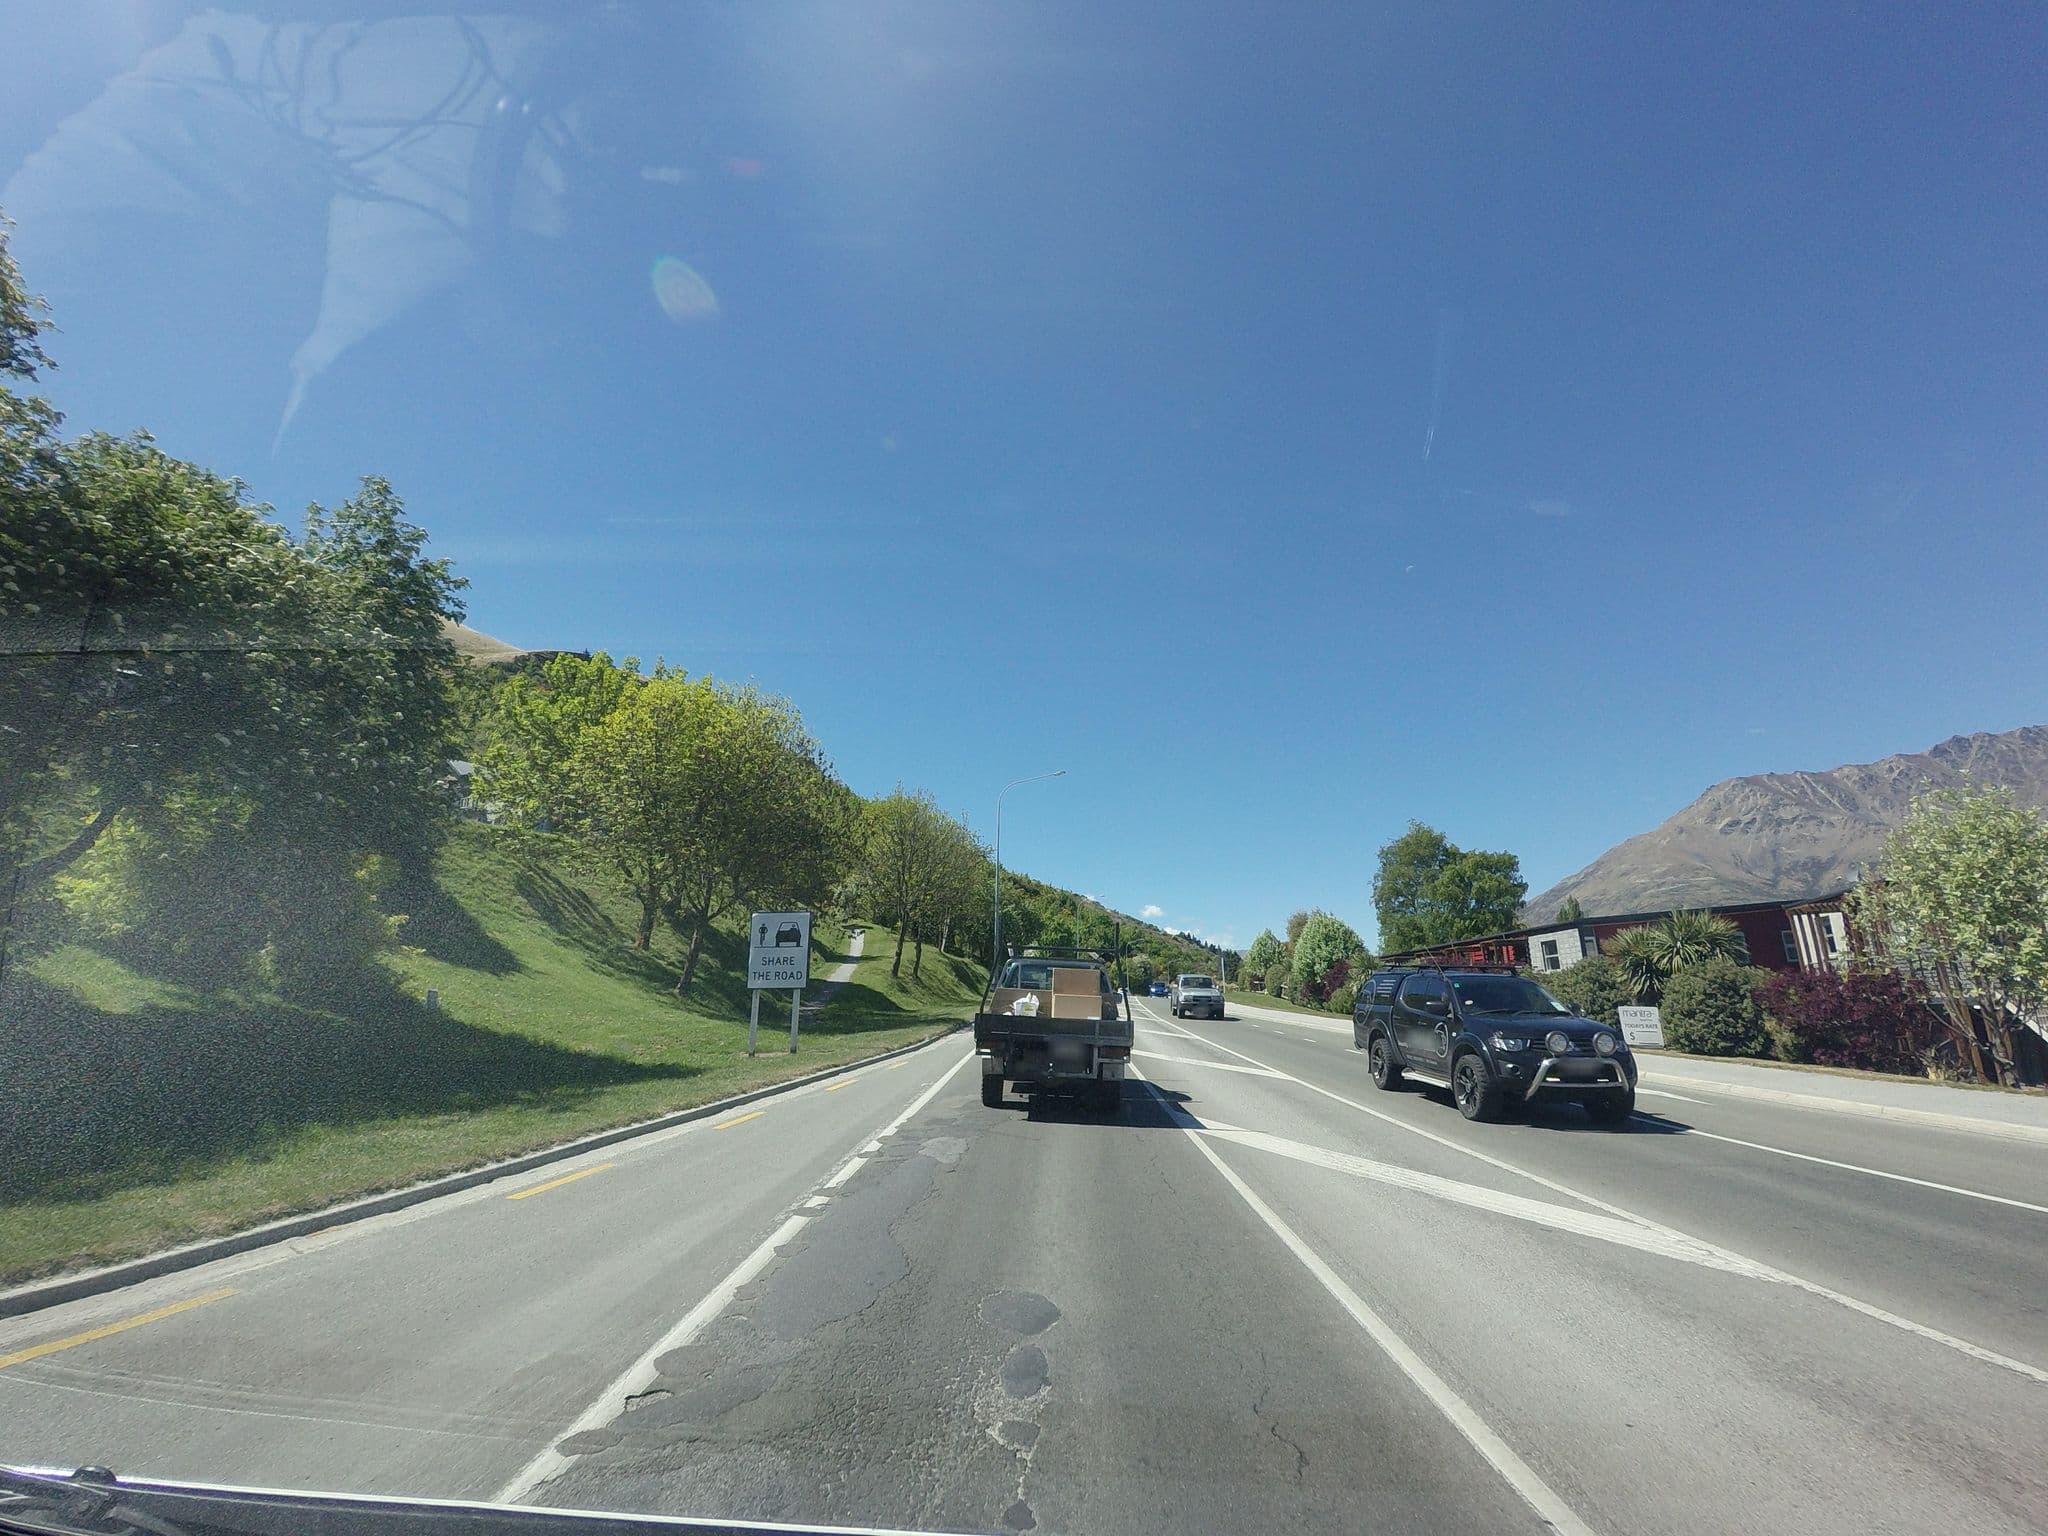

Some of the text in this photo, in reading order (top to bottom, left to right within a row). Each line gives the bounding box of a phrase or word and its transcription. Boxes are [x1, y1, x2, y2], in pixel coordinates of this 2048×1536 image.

[761, 956, 795, 966] SHARE
[752, 970, 803, 981] THE ROAD
[1629, 1031, 1636, 1040] $
